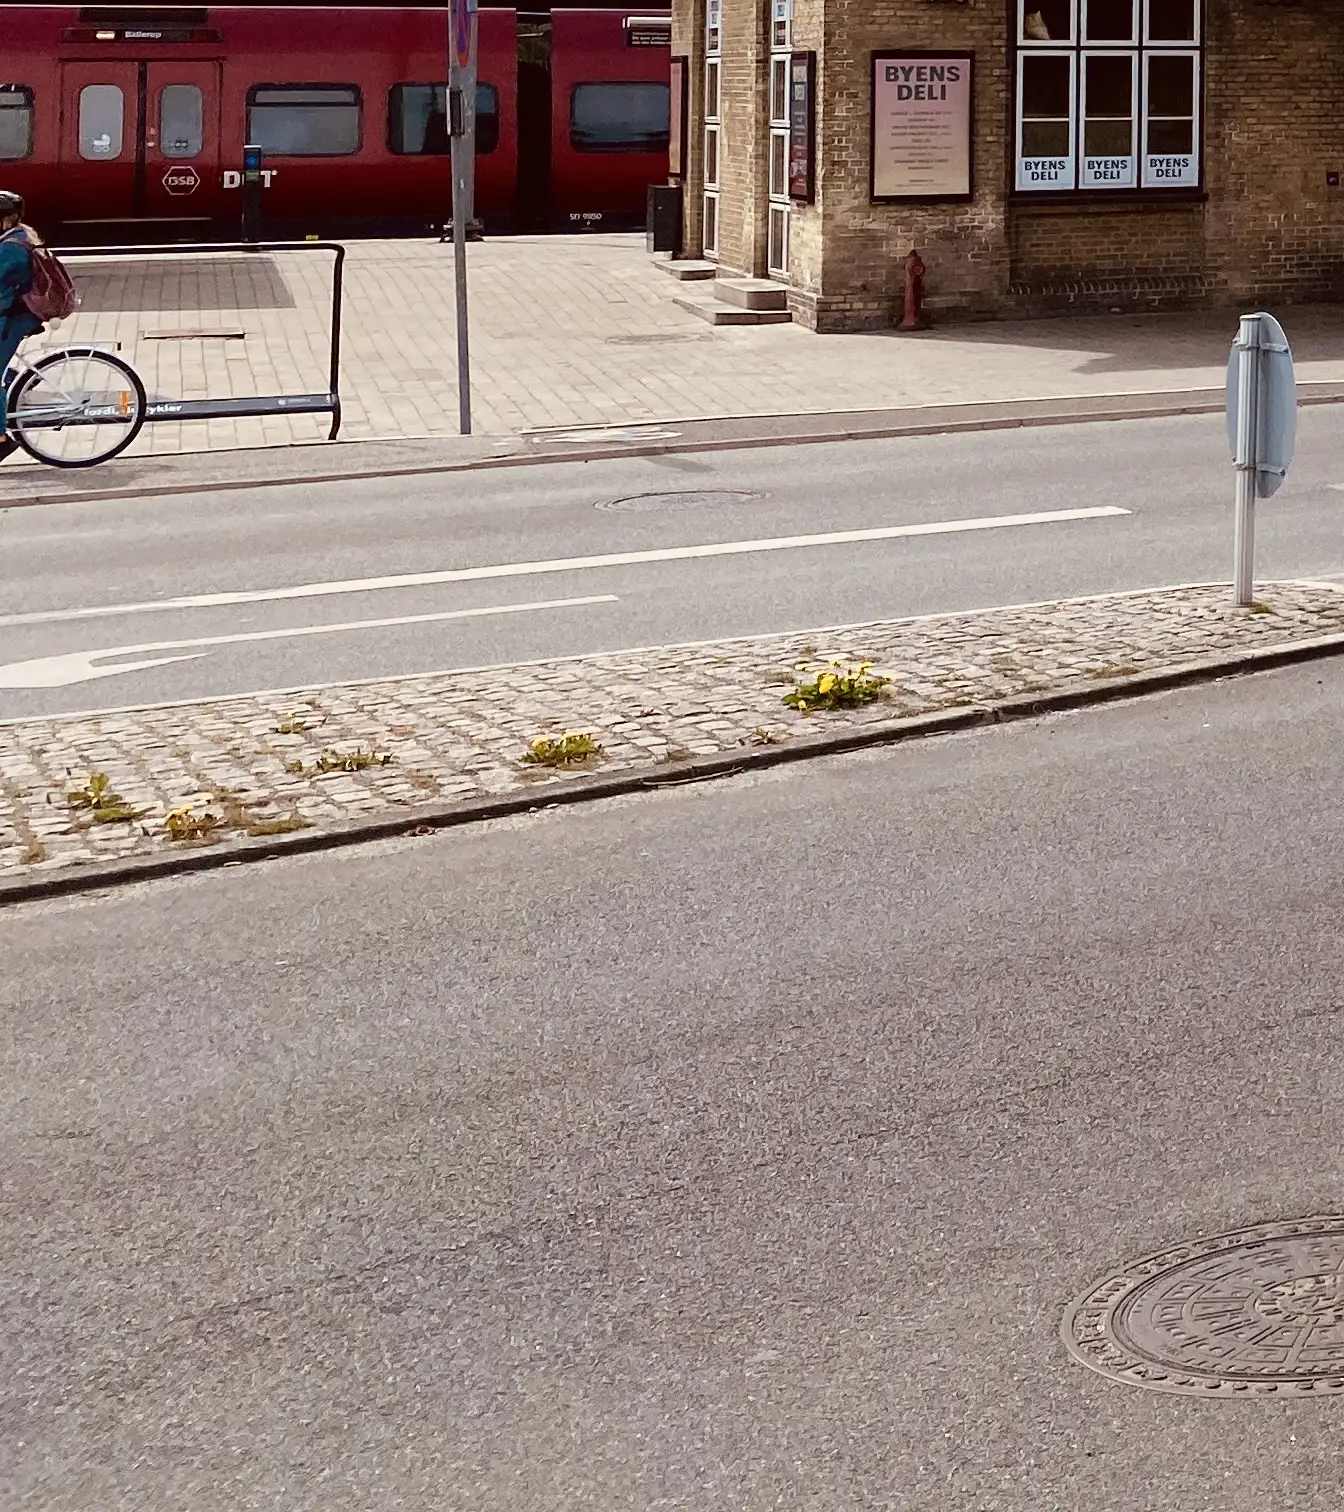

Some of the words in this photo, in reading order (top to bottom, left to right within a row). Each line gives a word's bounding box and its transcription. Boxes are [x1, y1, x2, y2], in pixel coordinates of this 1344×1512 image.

[885, 65, 960, 82] BYENS
[897, 84, 946, 101] DELI
[1024, 160, 1066, 171] BYENS
[1087, 159, 1128, 170] BYENS
[1149, 157, 1189, 168] BYENS
[1031, 171, 1058, 181] DELI
[1093, 170, 1121, 180] DELI
[1155, 168, 1182, 178] DELI
[223, 170, 272, 189] DT
[145, 404, 183, 416] ykler
